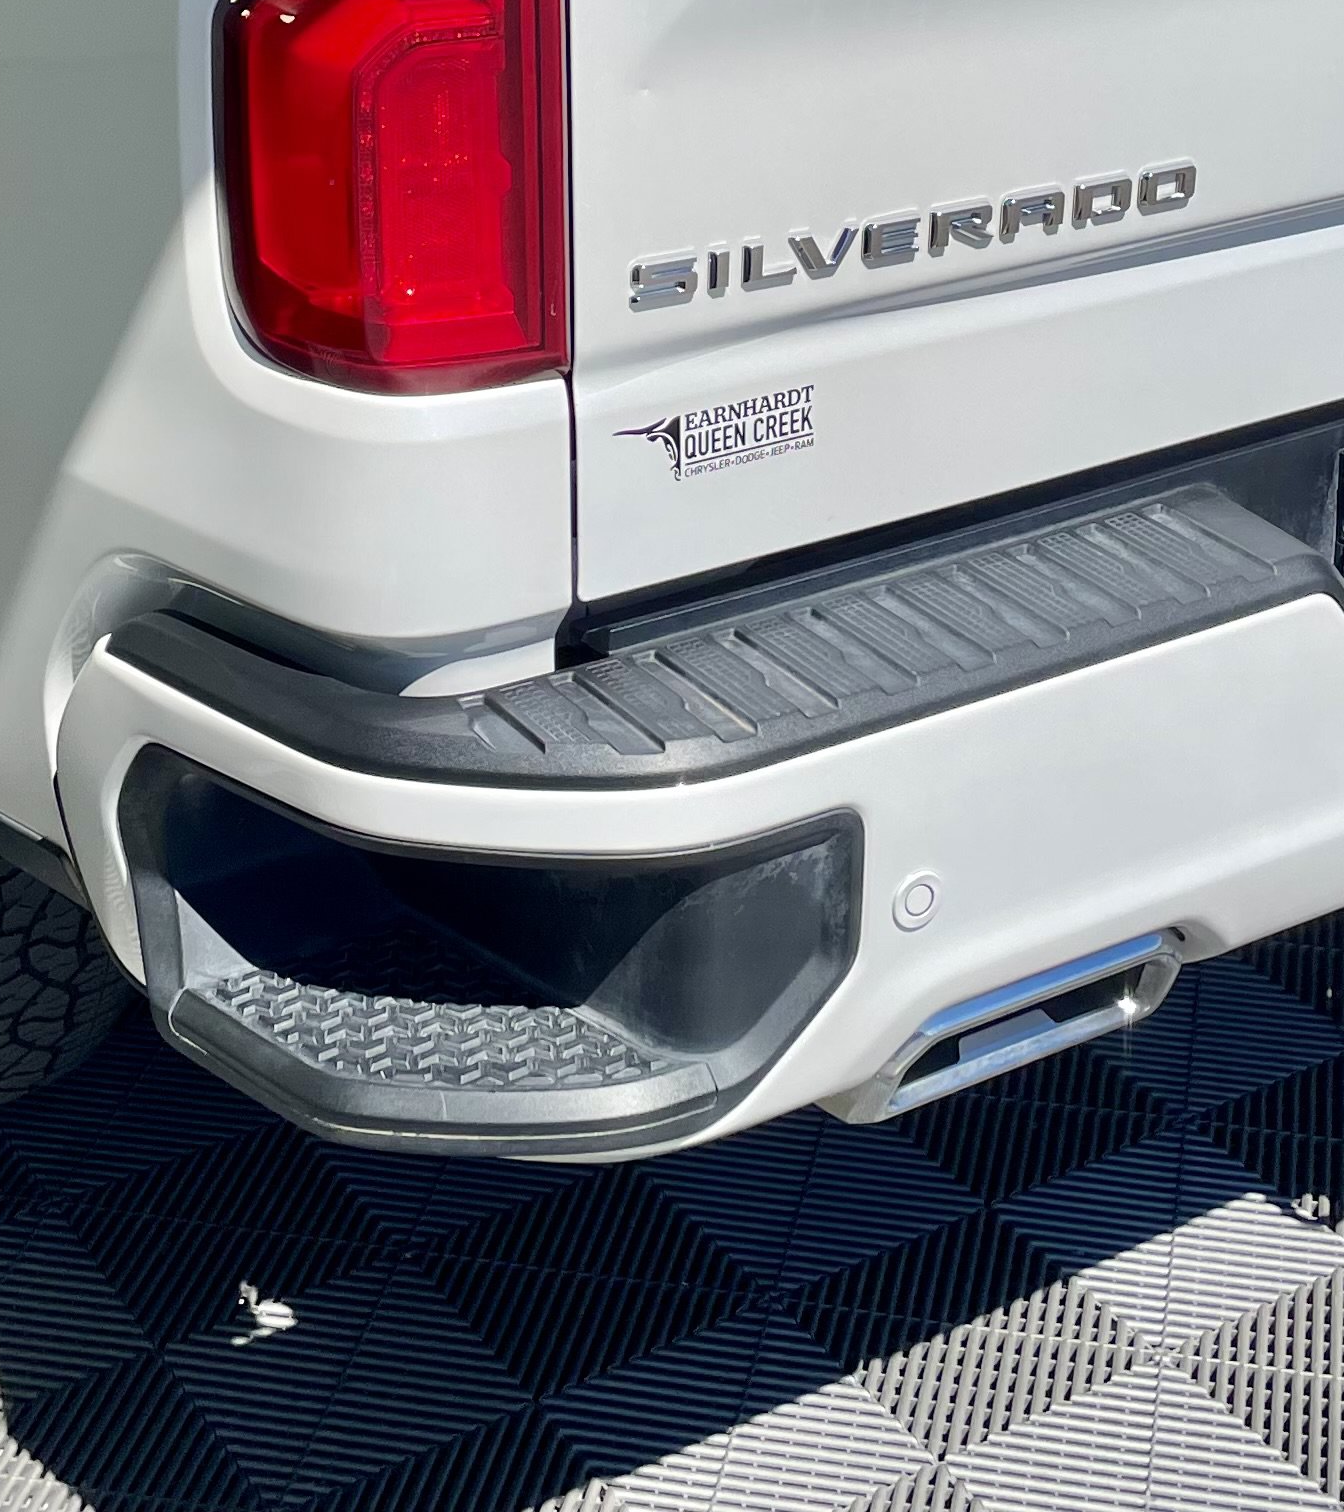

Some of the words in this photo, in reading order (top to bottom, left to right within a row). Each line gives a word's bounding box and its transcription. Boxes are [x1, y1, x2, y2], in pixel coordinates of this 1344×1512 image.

[628, 163, 1197, 310] SILVERADO
[684, 384, 815, 432] EARNHARDT
[684, 420, 746, 460] QUEEN
[753, 405, 814, 443] CREEK
